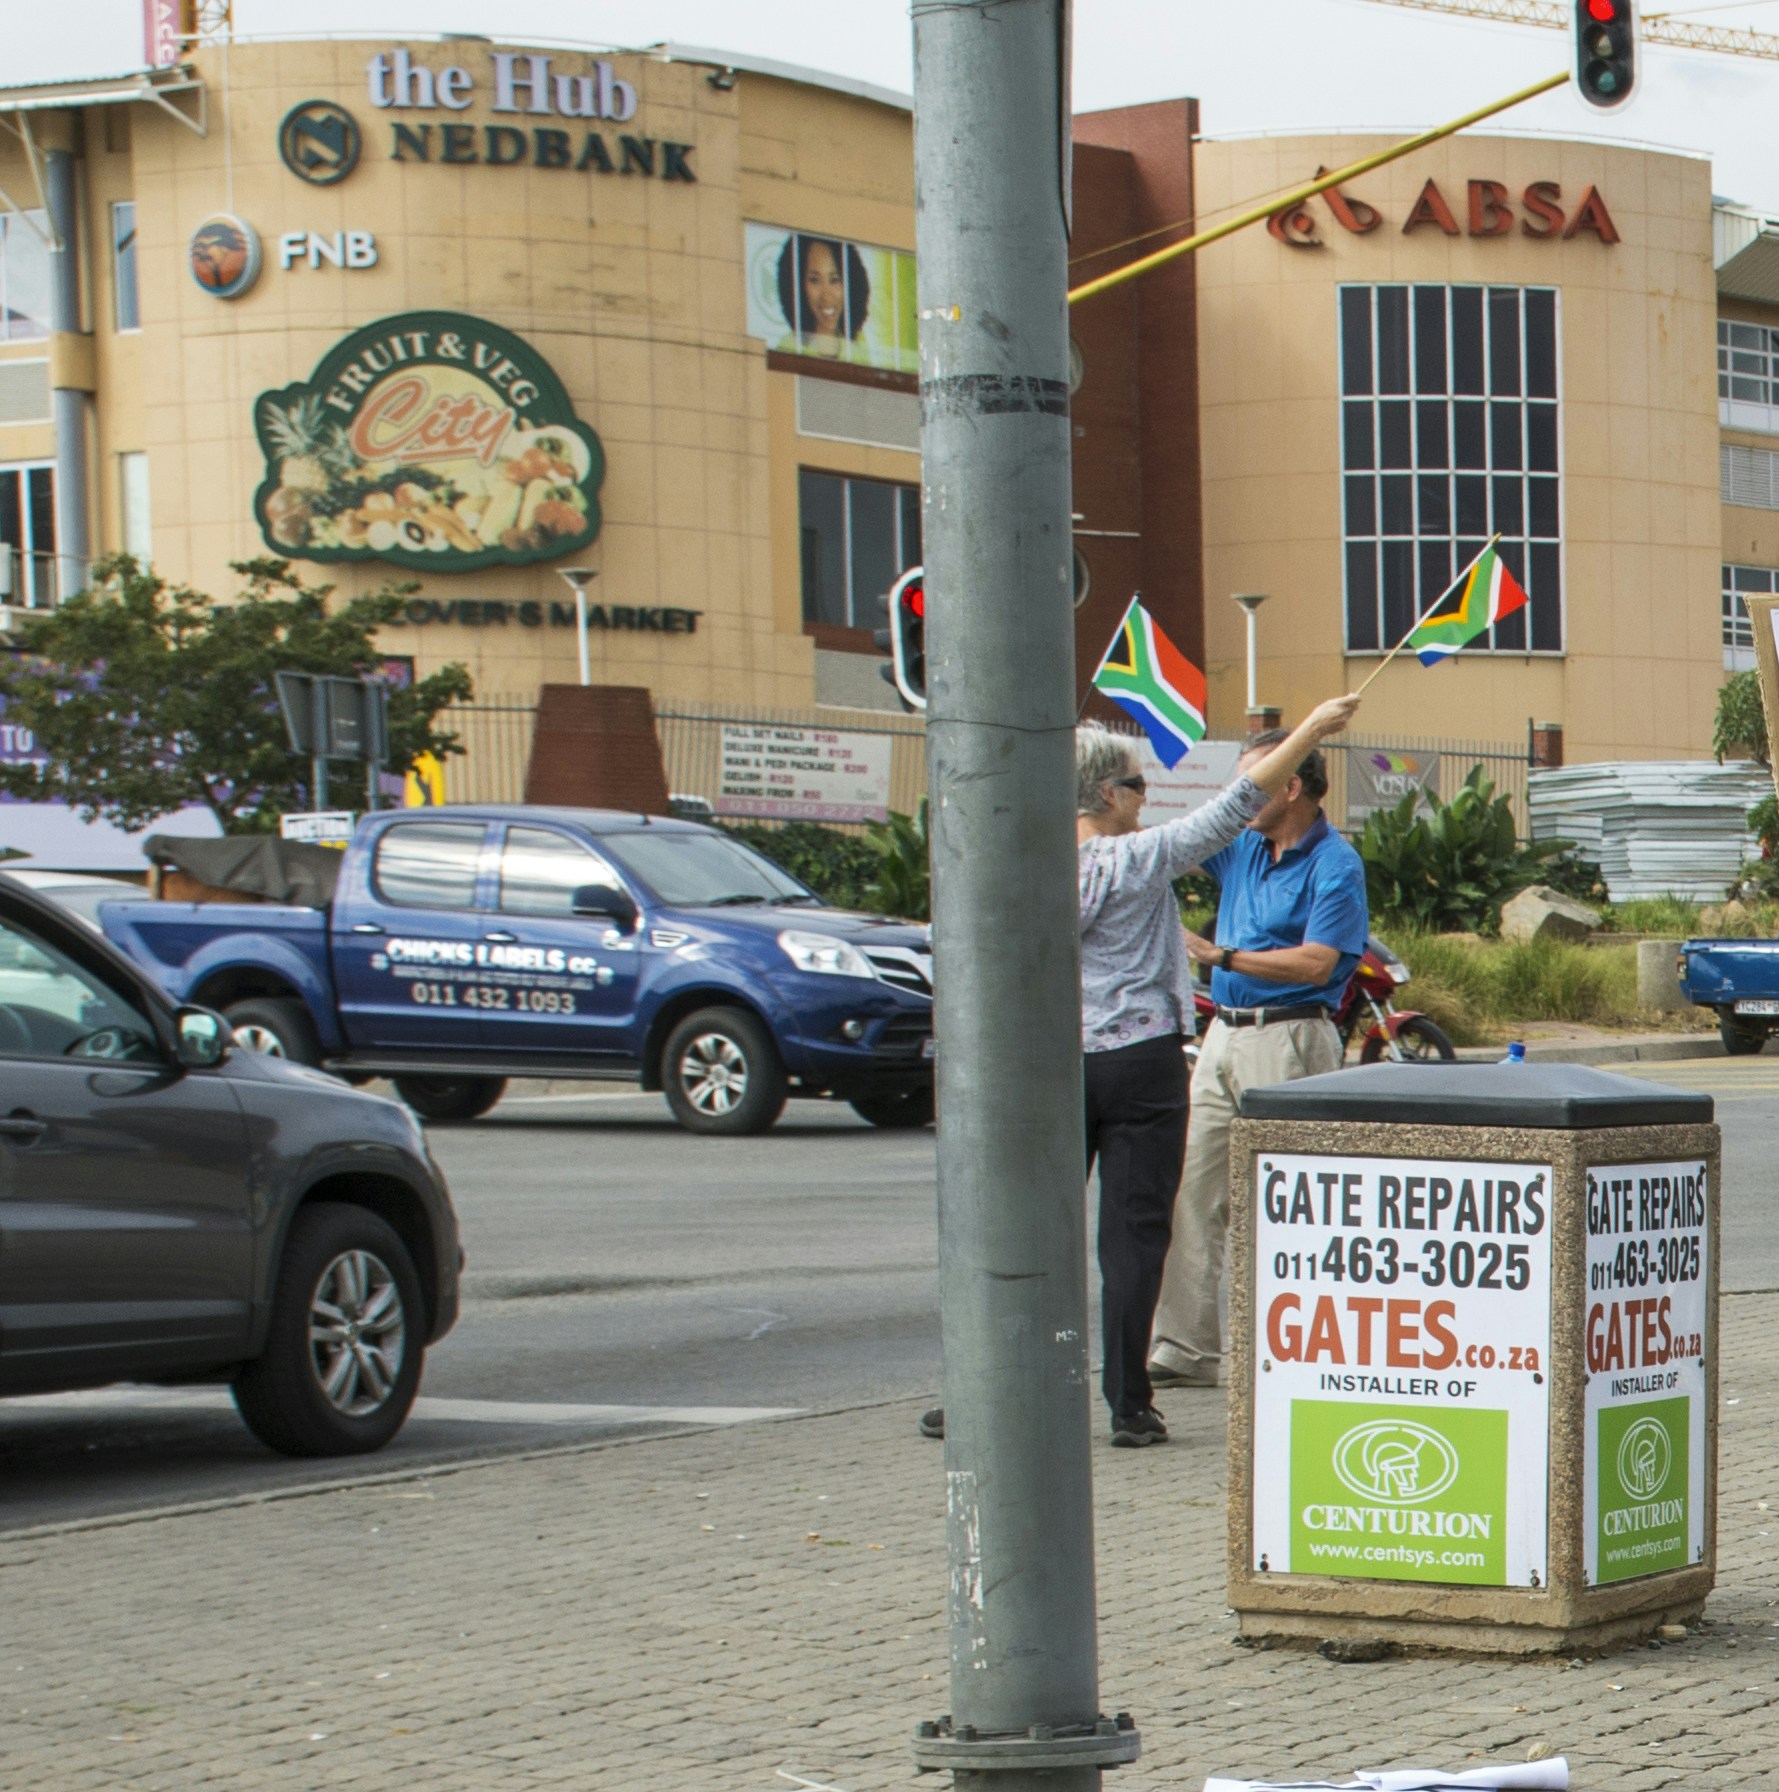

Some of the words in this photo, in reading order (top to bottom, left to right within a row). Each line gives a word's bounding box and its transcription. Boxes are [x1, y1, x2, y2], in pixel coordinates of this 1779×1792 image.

[364, 49, 473, 109] the
[490, 53, 638, 122] Hub
[391, 123, 698, 183] NEDBANK
[1402, 177, 1622, 245] ABSA
[279, 232, 379, 270] FNB
[329, 330, 430, 414] FRUIT
[436, 333, 466, 359] &
[472, 340, 540, 410] VEG
[349, 375, 515, 466] City
[550, 600, 703, 634] MARKET
[387, 938, 472, 965] CHICKS
[477, 946, 565, 972] LABELS
[412, 983, 457, 1005] 011
[464, 987, 509, 1009] 432
[516, 991, 576, 1013] 1093
[1264, 1171, 1363, 1227] GATE
[1379, 1177, 1545, 1237] REPAIRS
[1587, 1176, 1632, 1237] GATE
[1639, 1174, 1705, 1228] REPAIRS
[1320, 1373, 1439, 1397] INSTALLER
[1447, 1380, 1477, 1398] OF
[1611, 1375, 1661, 1397] INSTALLER
[1665, 1373, 1678, 1389] OF
[1302, 1504, 1492, 1540] CENTURION
[1603, 1498, 1684, 1534] CENTURION
[1310, 1539, 1485, 1567] www.centsys.com
[1606, 1536, 1682, 1565] www.centsys.com
